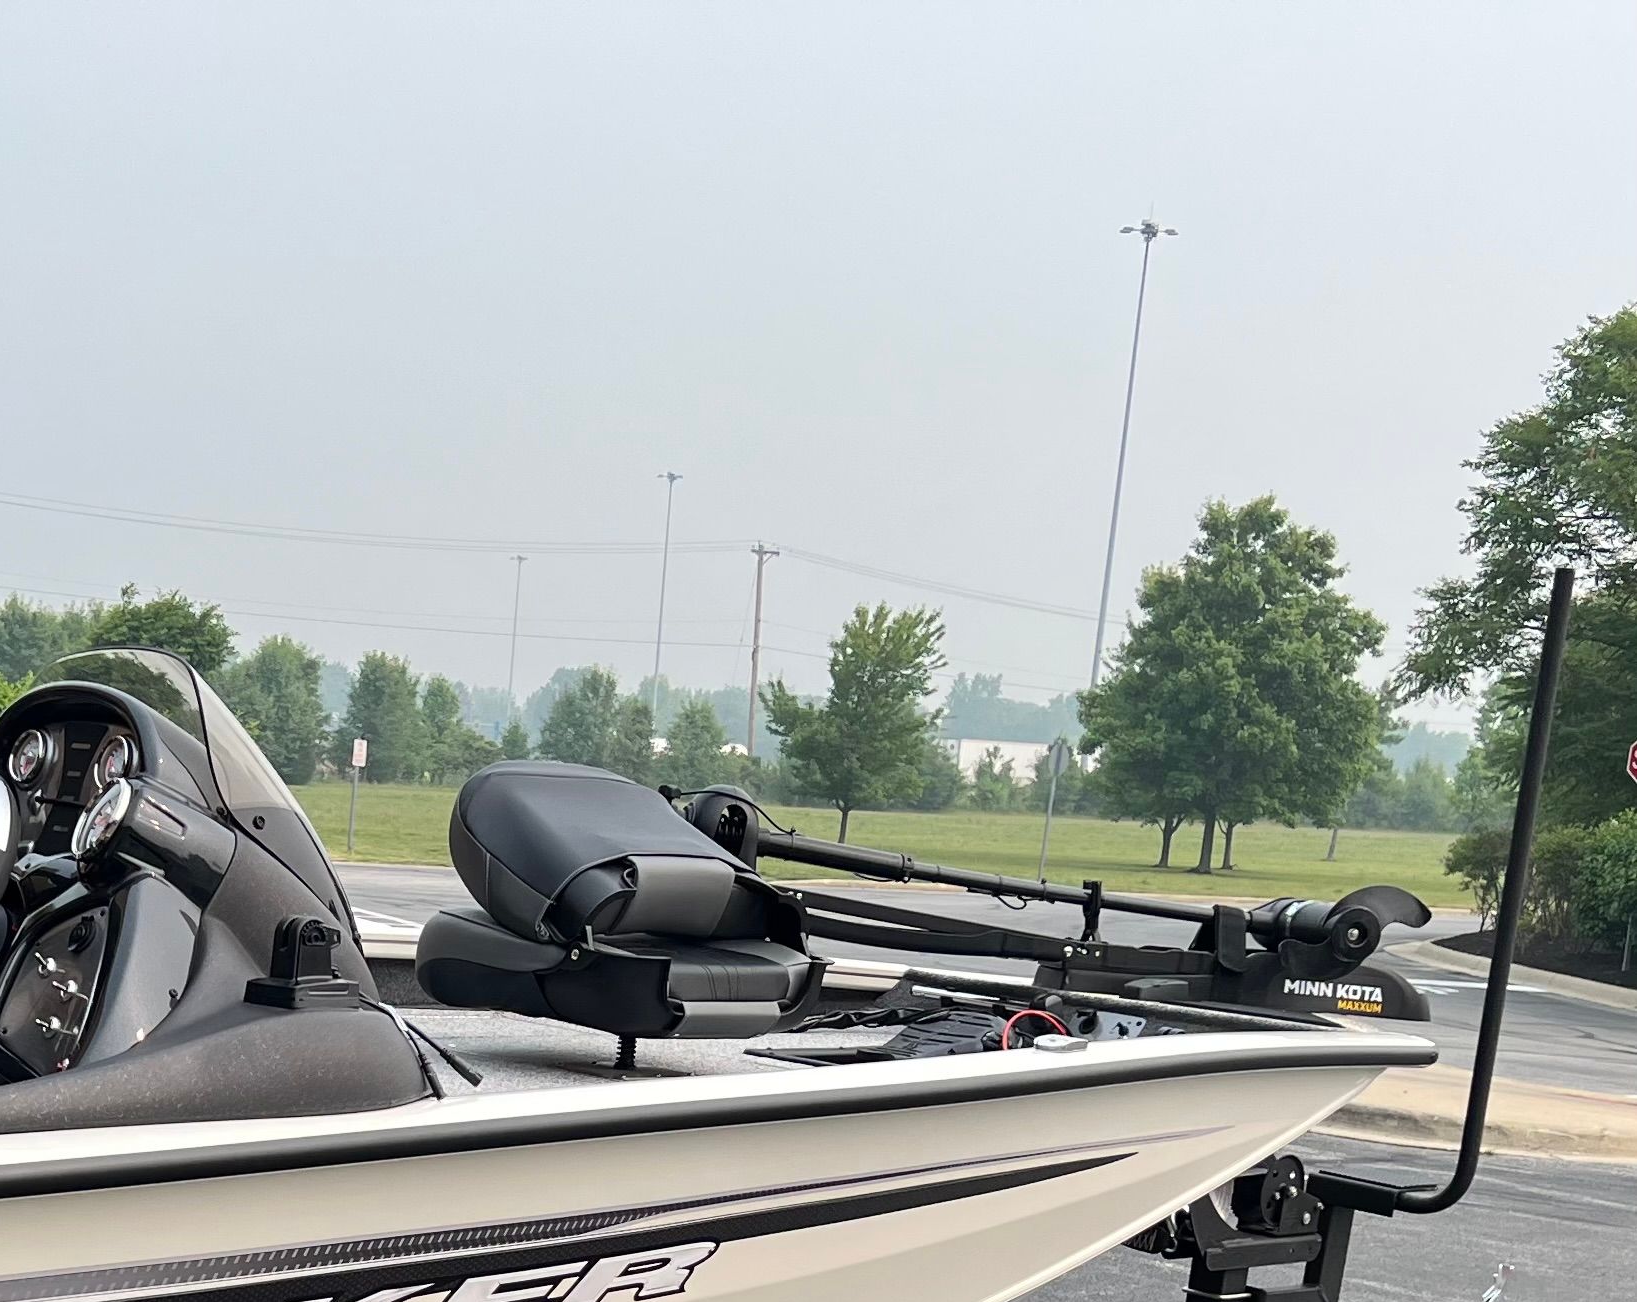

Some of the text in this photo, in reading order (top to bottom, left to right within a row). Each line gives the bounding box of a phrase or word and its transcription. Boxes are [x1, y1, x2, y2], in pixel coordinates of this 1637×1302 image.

[1283, 978, 1383, 1003] MINN KOTA
[1337, 999, 1383, 1014] MAXXUM
